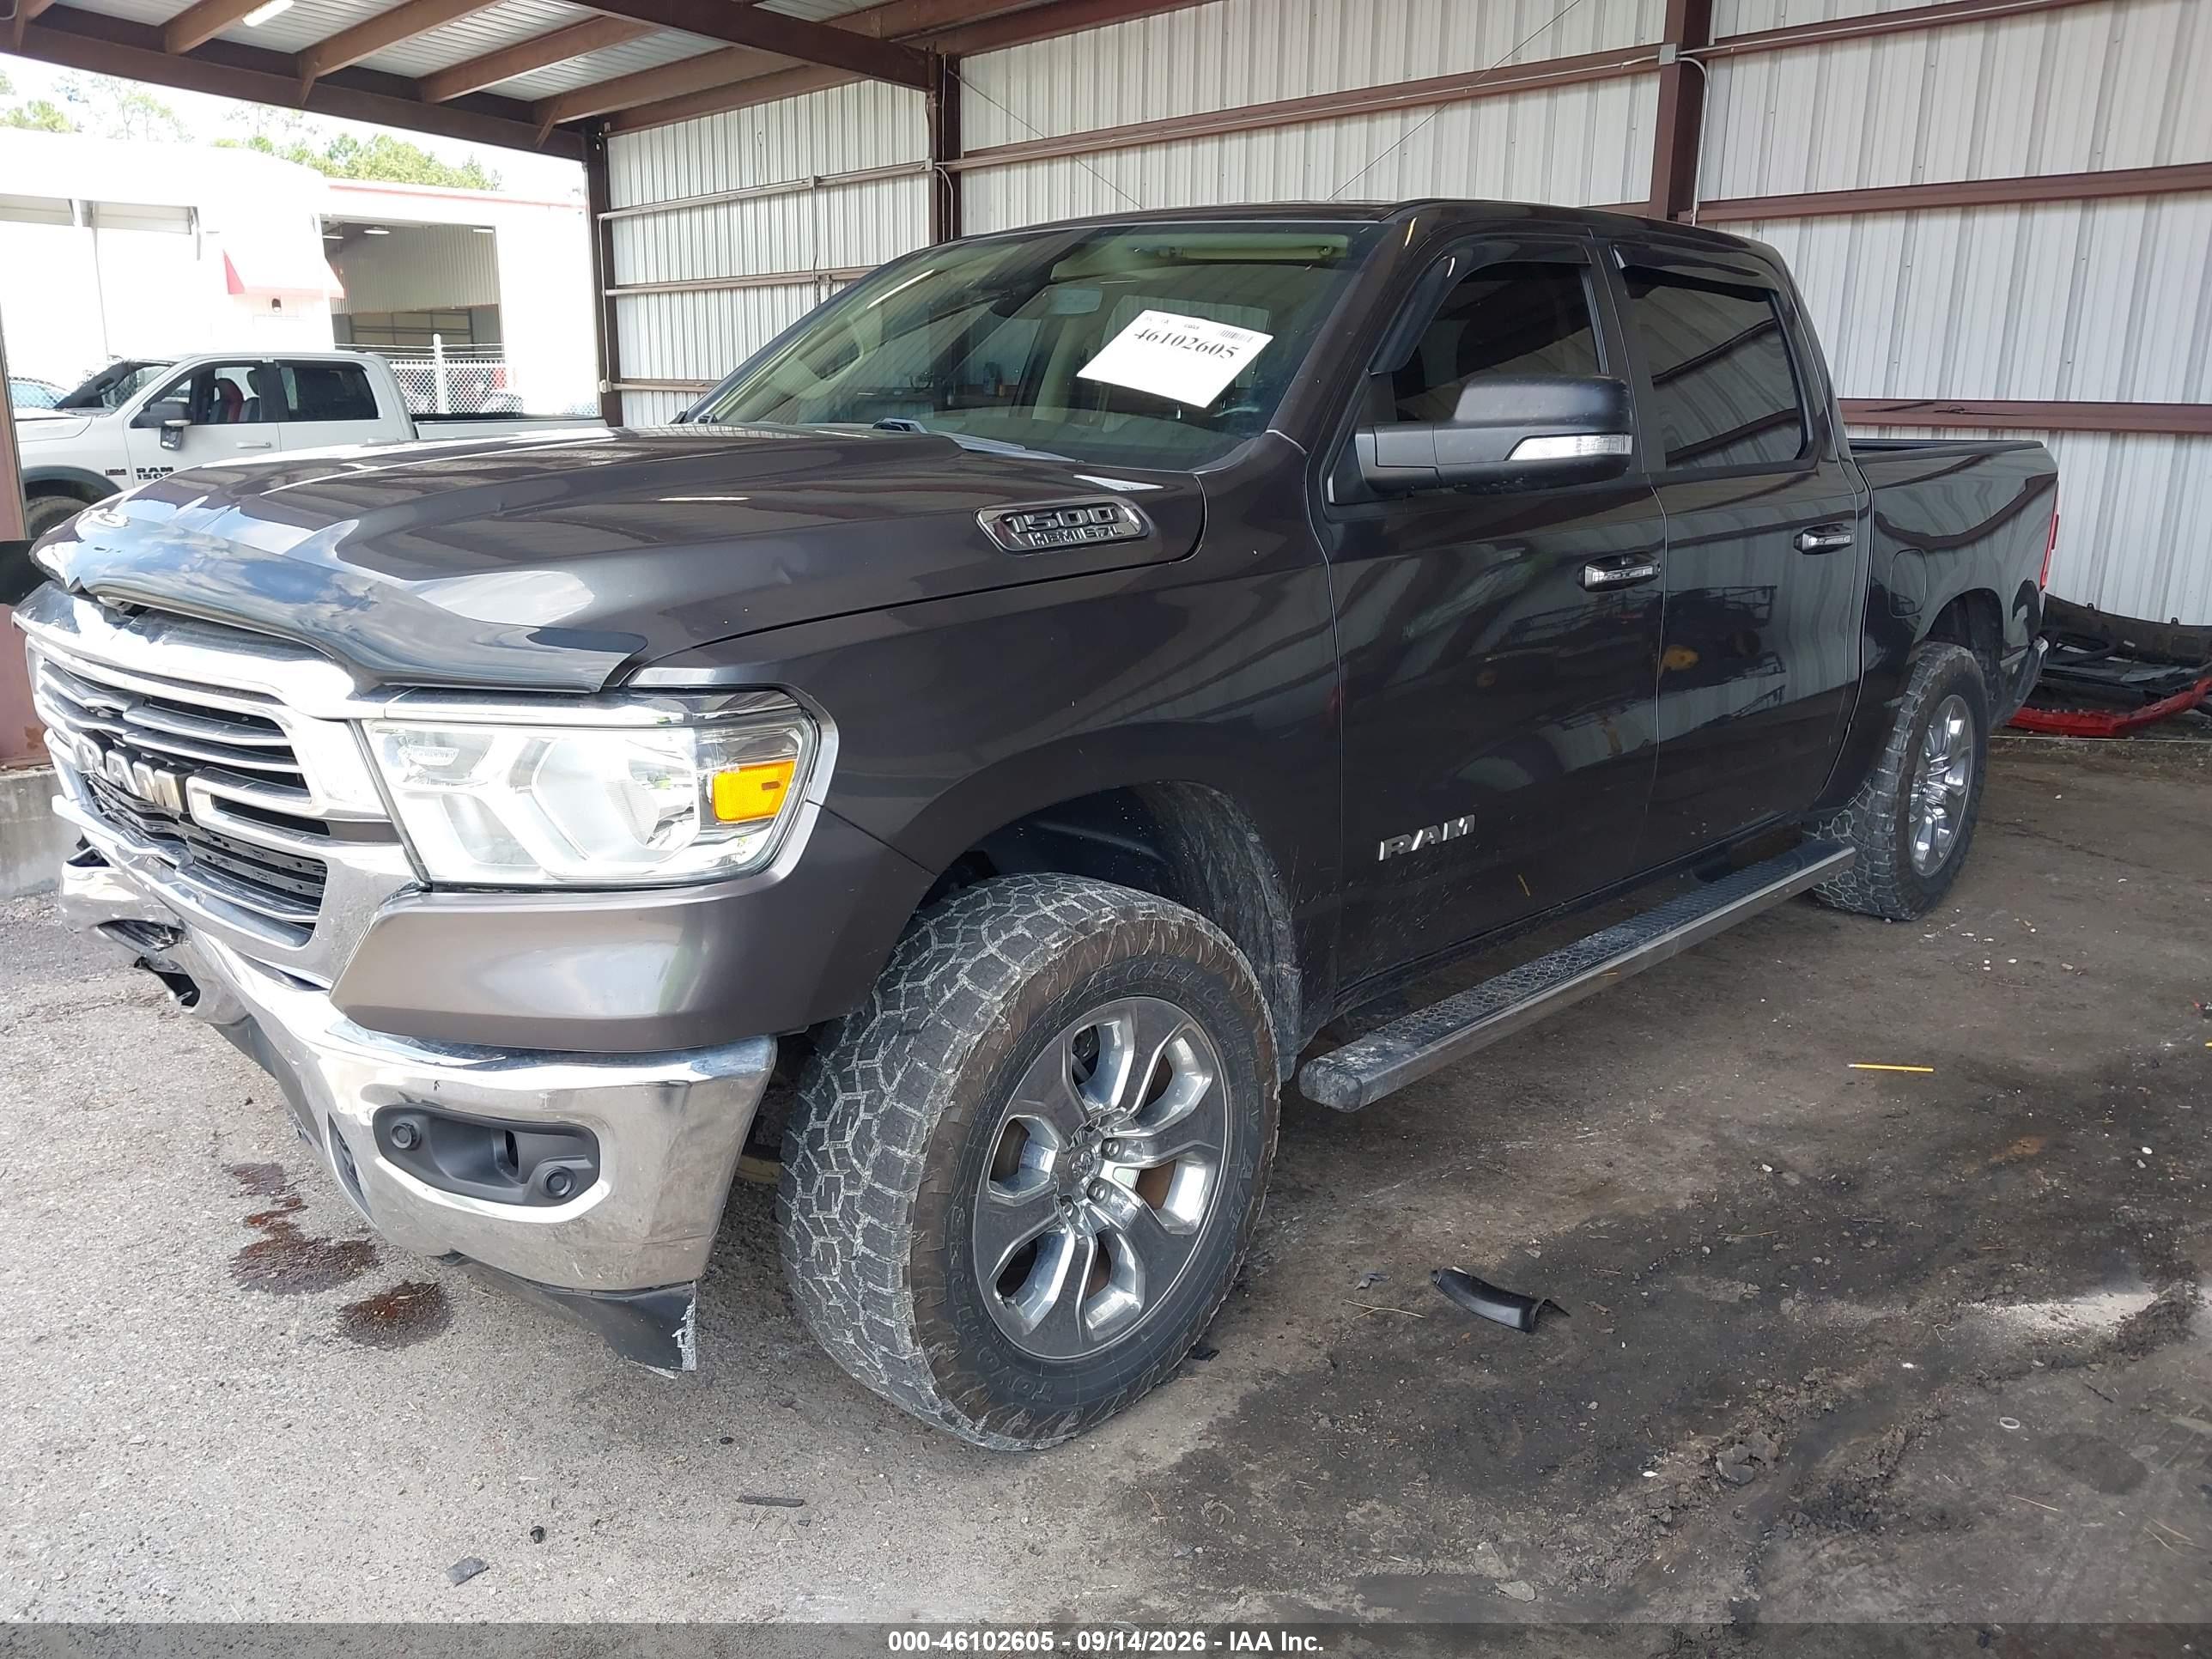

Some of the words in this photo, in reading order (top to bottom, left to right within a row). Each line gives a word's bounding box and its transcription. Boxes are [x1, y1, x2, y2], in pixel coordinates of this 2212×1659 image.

[1133, 328, 1239, 359] 46102605
[1006, 507, 1118, 533] 1500
[1028, 527, 1085, 547] HEMI
[1378, 814, 1474, 861] RAM
